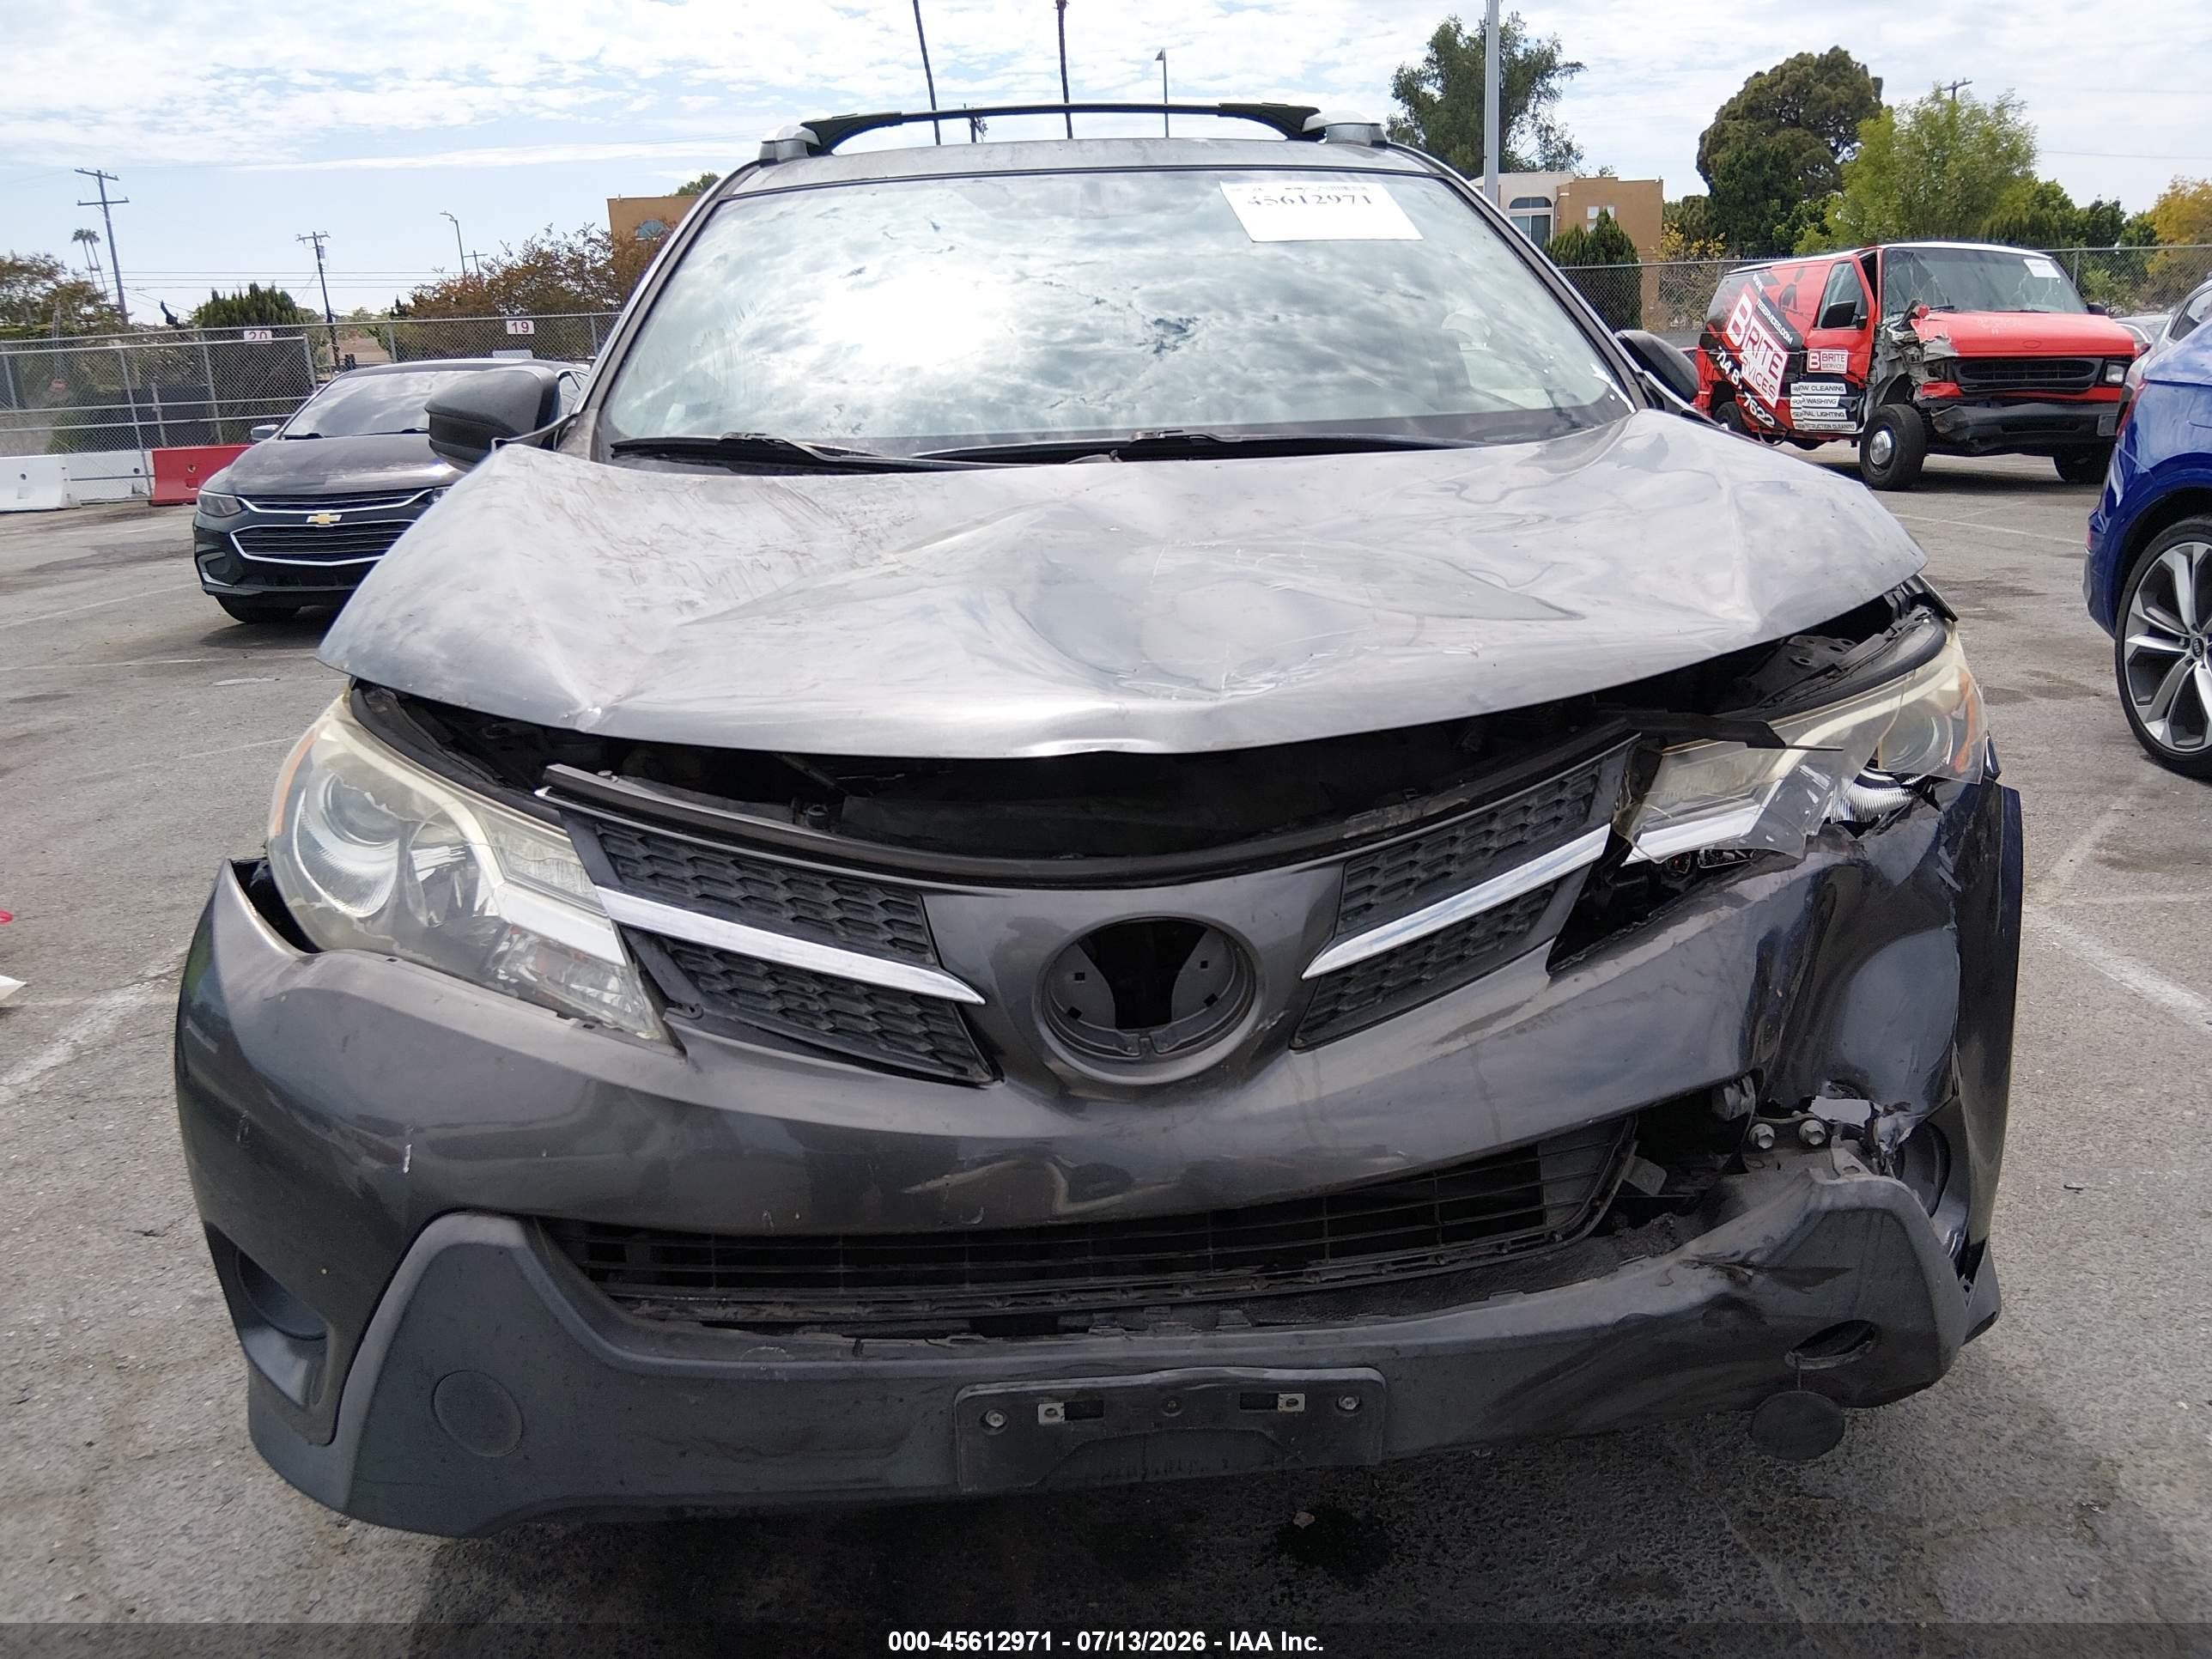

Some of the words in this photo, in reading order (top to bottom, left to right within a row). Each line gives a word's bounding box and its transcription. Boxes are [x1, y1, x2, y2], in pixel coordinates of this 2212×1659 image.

[511, 321, 529, 333] 19
[248, 331, 268, 340] 20
[1726, 293, 1784, 380] BRITE
[1809, 353, 1820, 368] B
[1822, 353, 1845, 362] BRITE
[1742, 355, 1776, 399] RVICES
[1743, 391, 1775, 428] 7622
